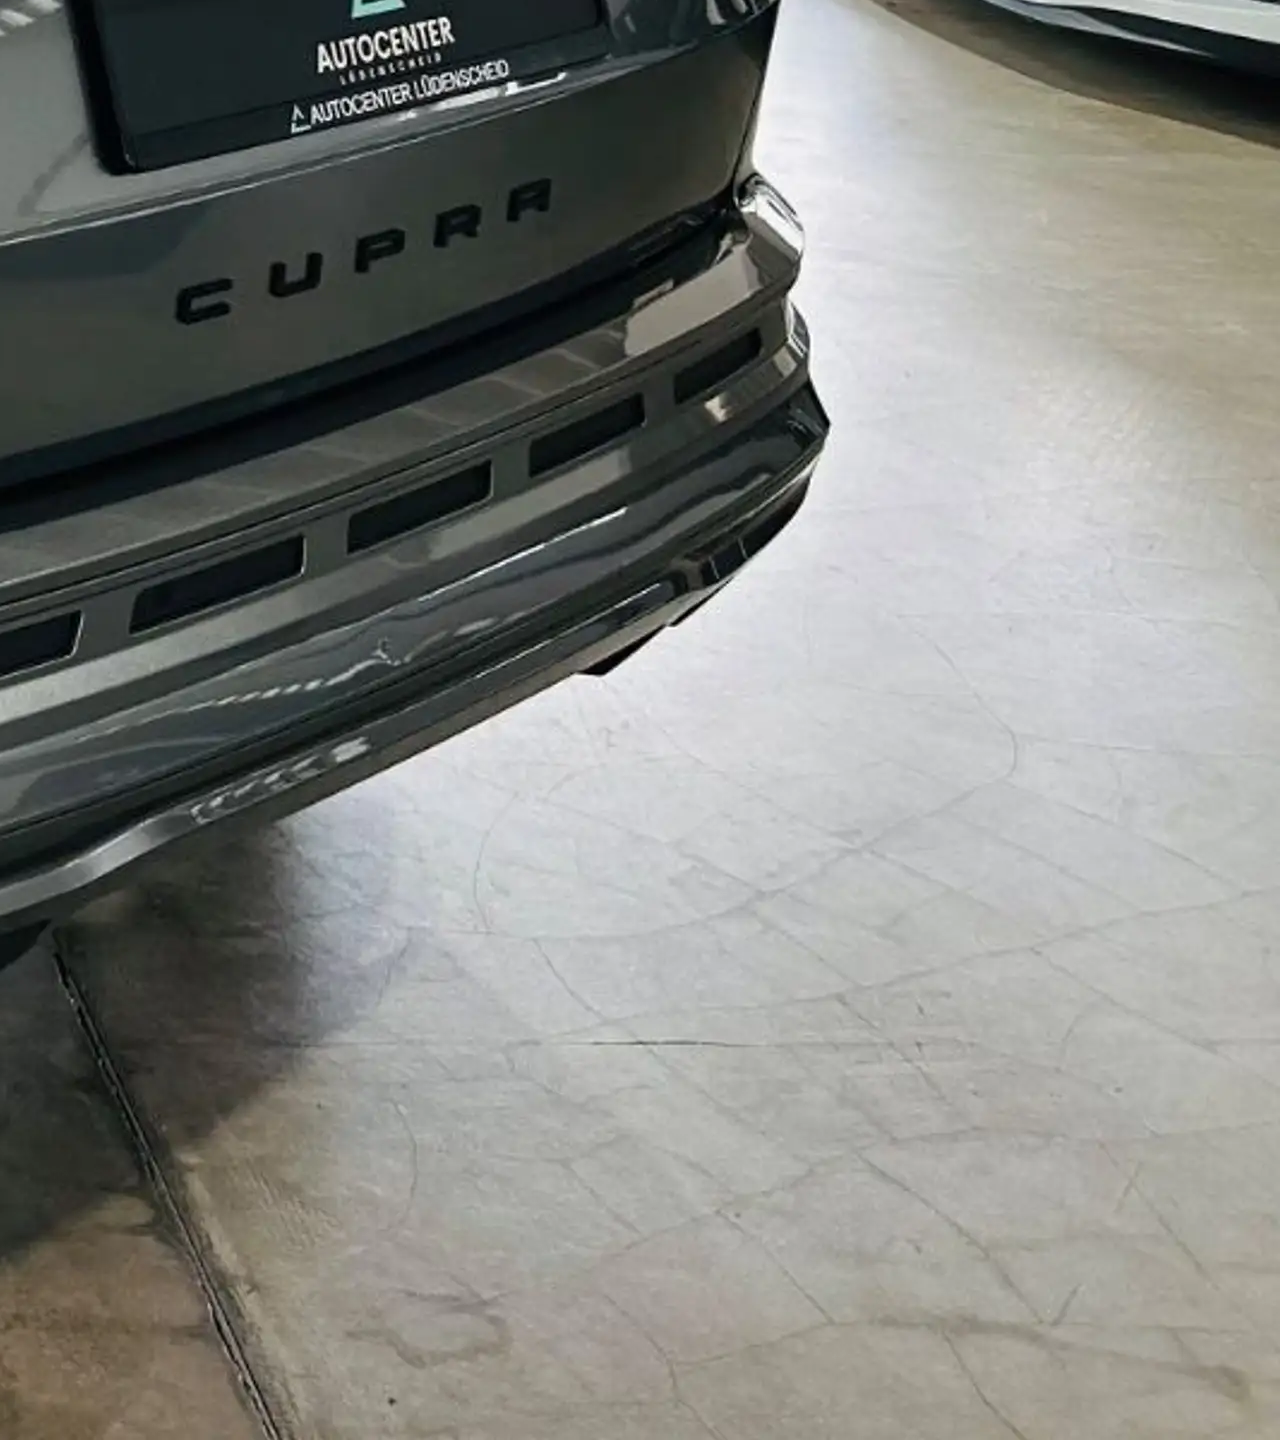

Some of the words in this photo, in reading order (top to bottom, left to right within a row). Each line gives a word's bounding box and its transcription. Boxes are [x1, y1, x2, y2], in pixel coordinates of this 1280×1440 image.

[316, 16, 455, 74] AUTOCENTER
[310, 84, 413, 125] AUTOCENTER
[415, 59, 509, 100] LÜDENSCHEID
[175, 178, 552, 324] CUPRA
